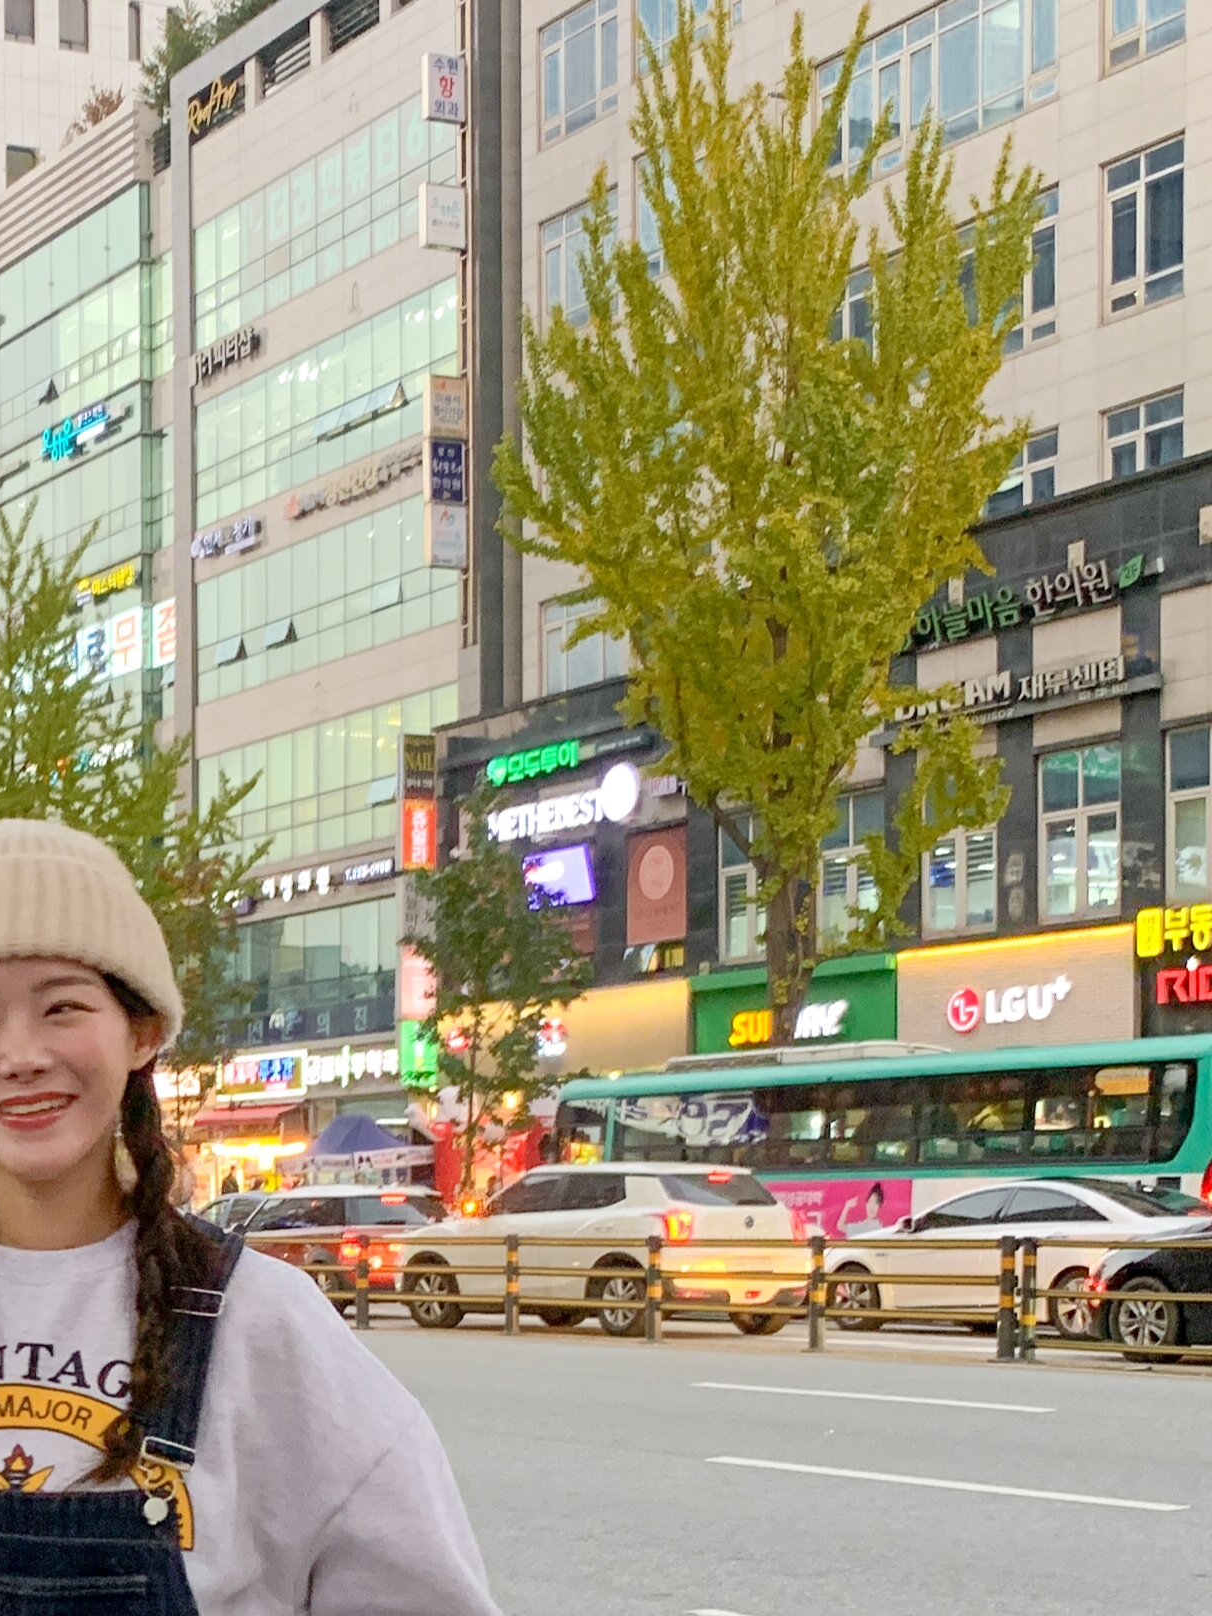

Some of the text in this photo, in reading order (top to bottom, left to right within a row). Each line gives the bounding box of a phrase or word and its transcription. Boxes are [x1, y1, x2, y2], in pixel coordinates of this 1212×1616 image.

[433, 57, 459, 76] 수원
[439, 75, 455, 99] 항
[434, 100, 460, 118] 외과
[916, 583, 1022, 645] 하늘마음
[1024, 558, 1114, 618] 한의원
[1017, 654, 1126, 703] 재무센터
[729, 999, 849, 1047] SUAY
